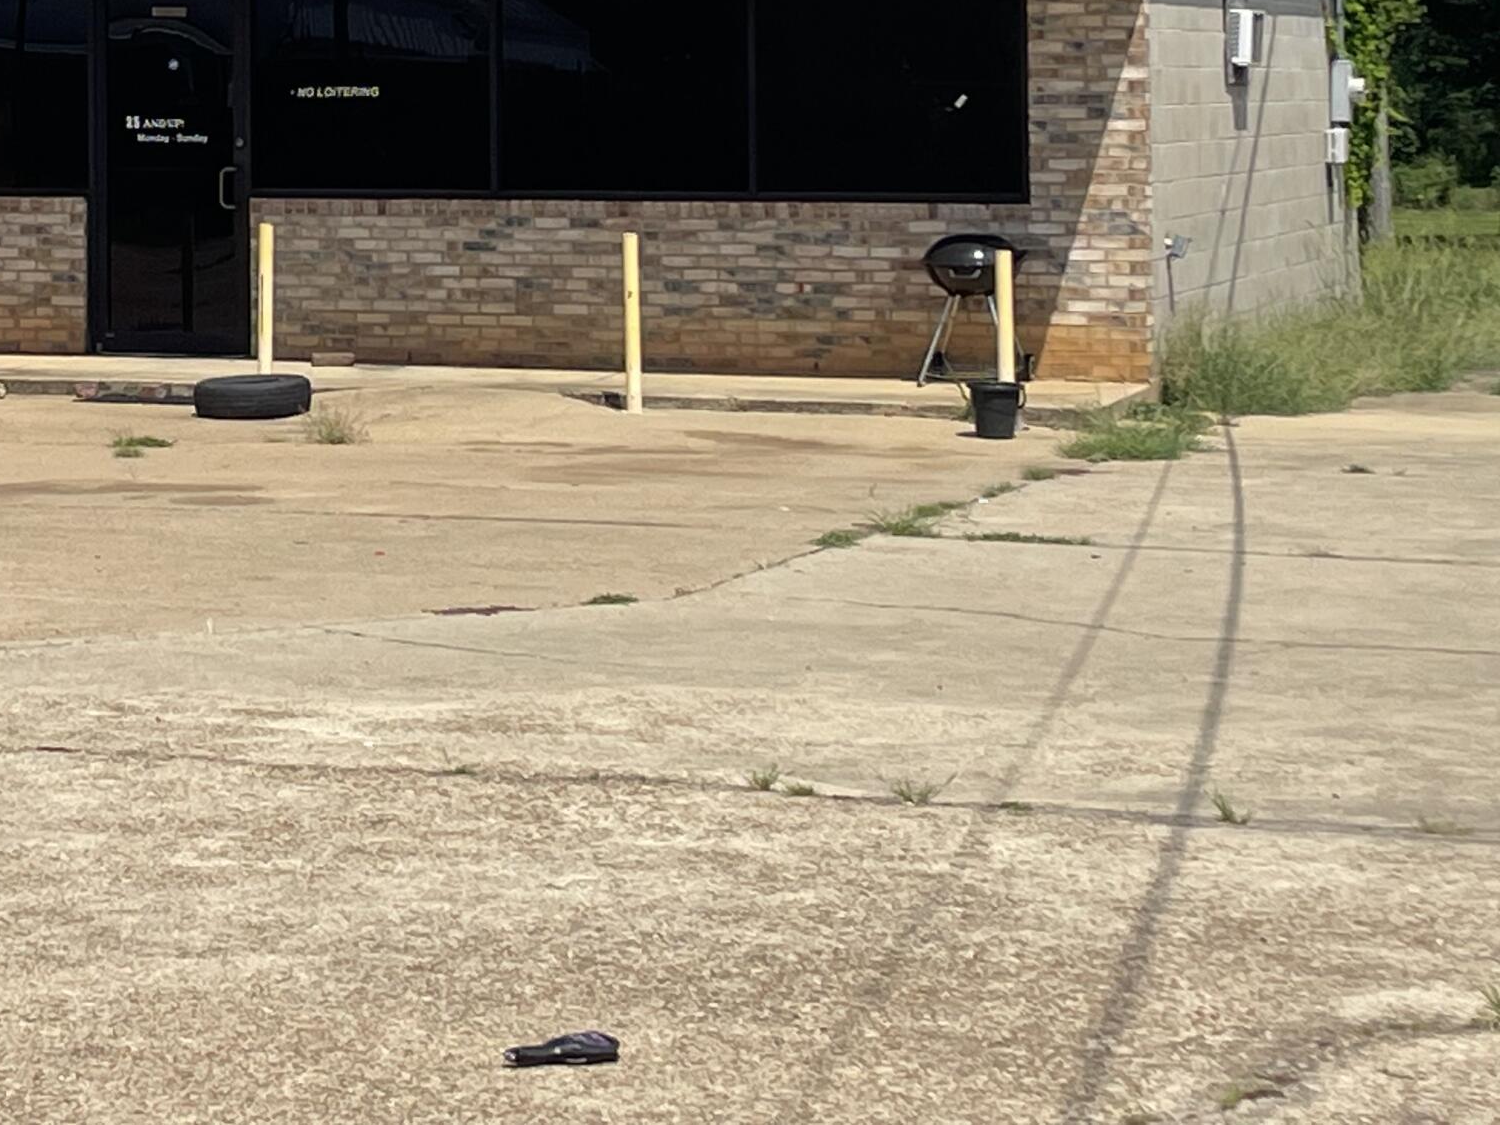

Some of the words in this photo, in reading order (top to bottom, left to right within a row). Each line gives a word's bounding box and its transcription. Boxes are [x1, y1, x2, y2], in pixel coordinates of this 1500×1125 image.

[296, 86, 315, 98] NO
[316, 86, 379, 98] LOITERING
[137, 132, 170, 143] Monday
[176, 132, 209, 144] Sunday
